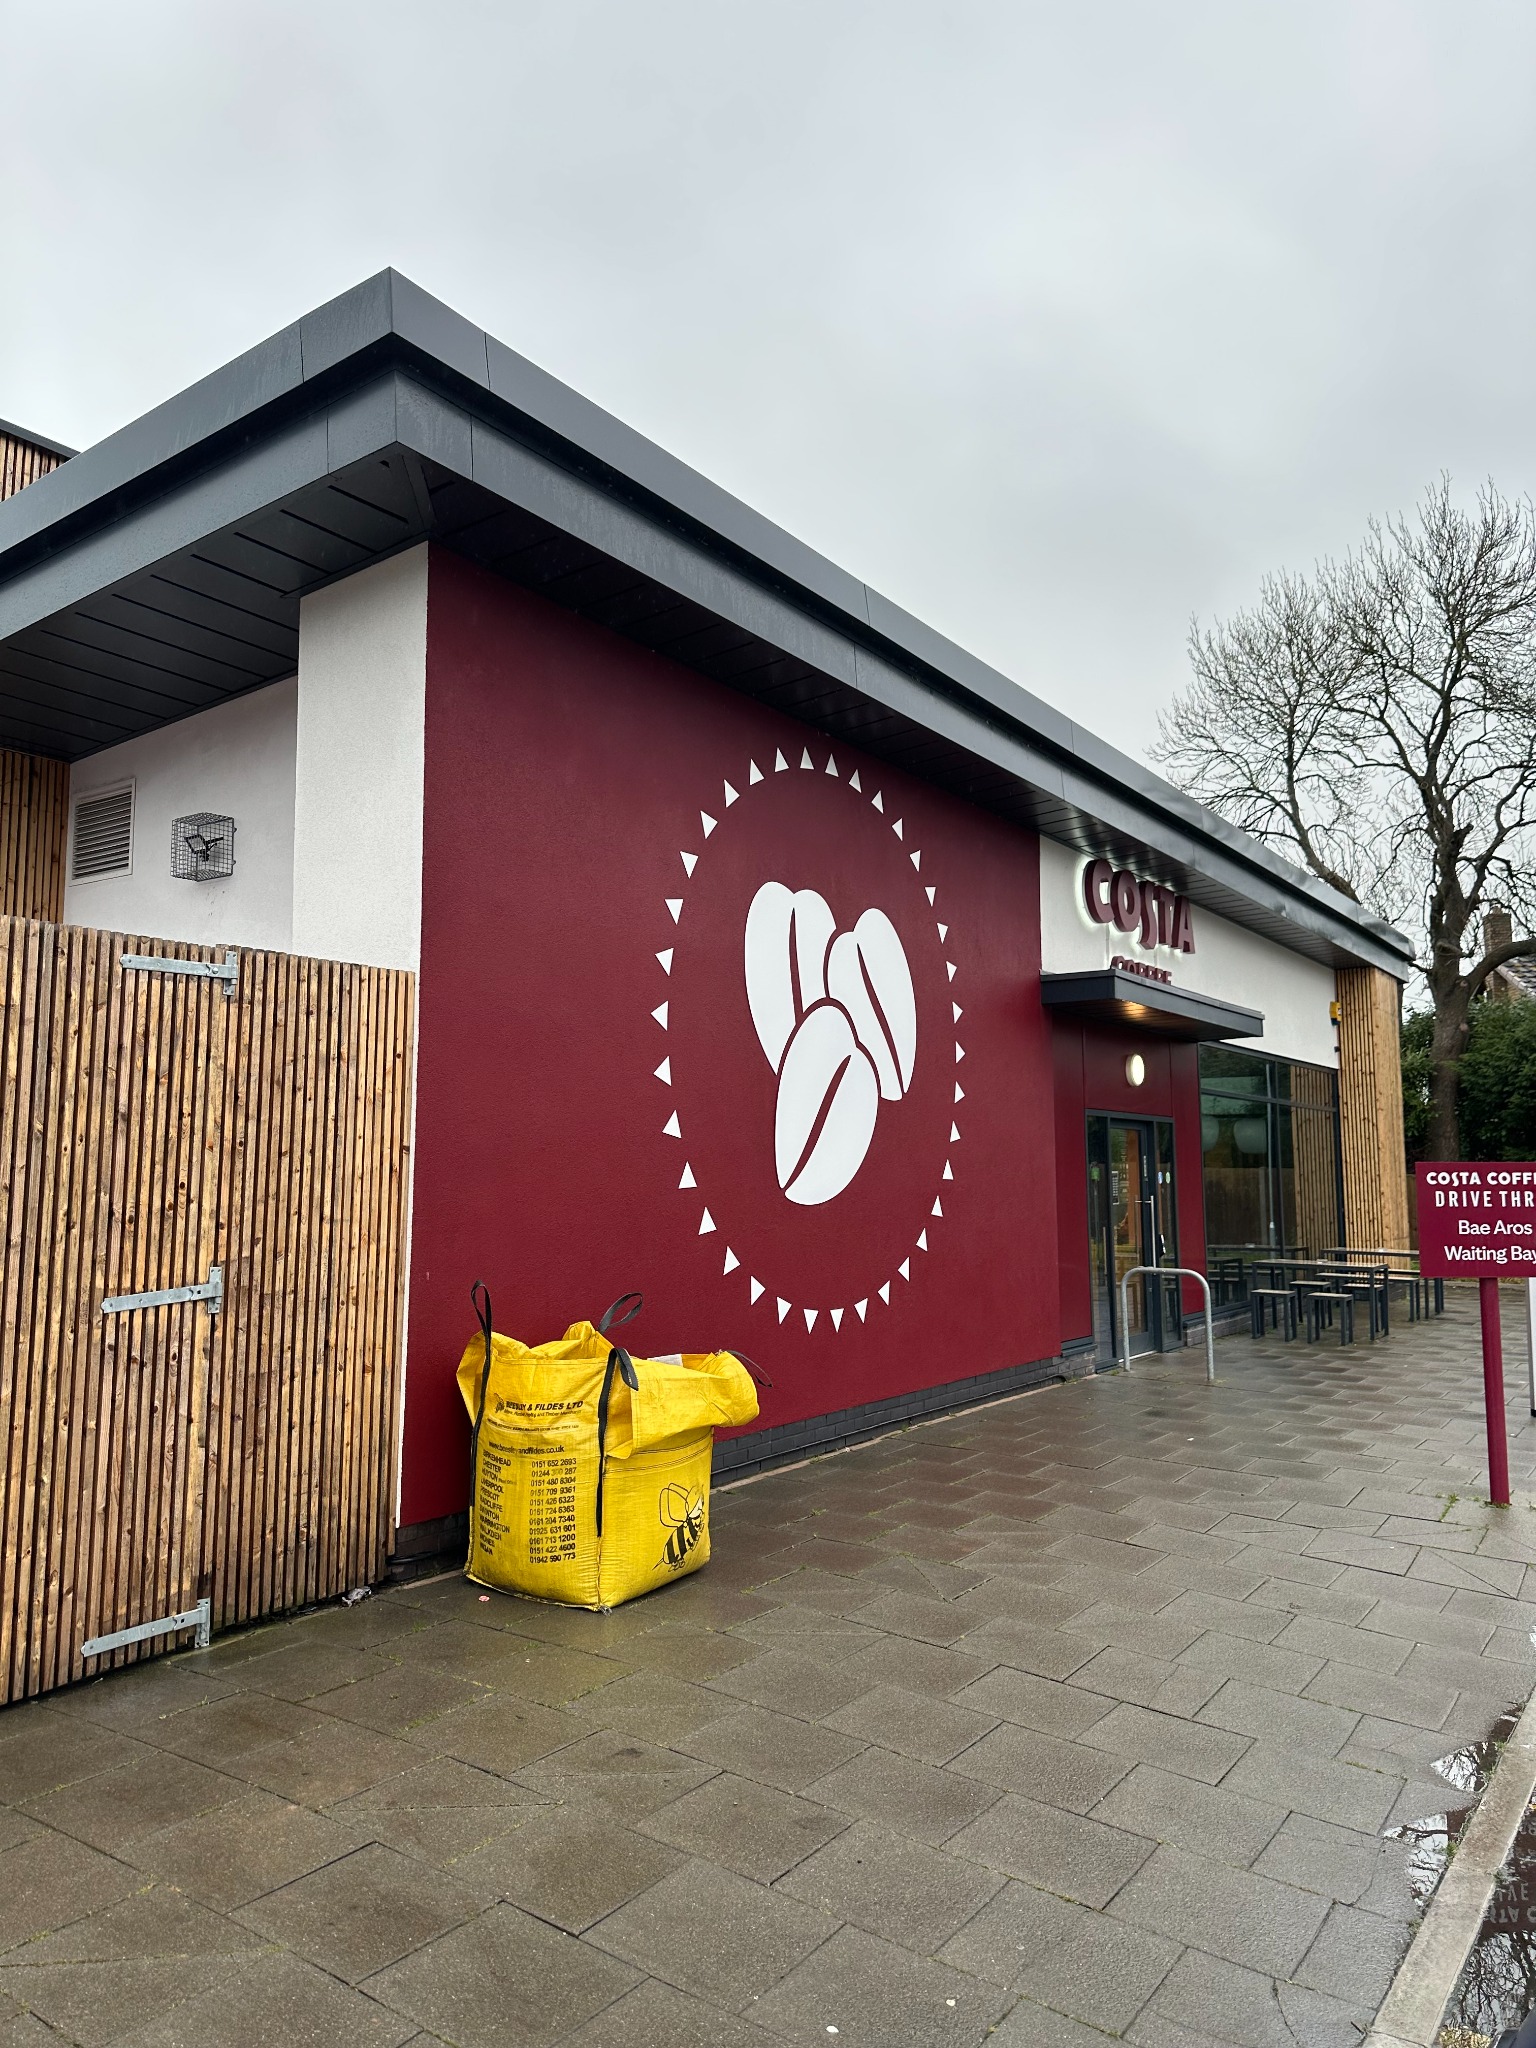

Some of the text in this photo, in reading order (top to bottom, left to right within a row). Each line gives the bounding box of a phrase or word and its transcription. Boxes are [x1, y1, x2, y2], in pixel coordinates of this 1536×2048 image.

[1084, 858, 1196, 954] COSTA
[1426, 1172, 1536, 1187] COSTA COFF
[1435, 1190, 1493, 1208] DRIVE
[1458, 1219, 1533, 1235] Bae Aros
[1444, 1245, 1507, 1265] Waiting
[527, 1403, 533, 1412] &
[534, 1403, 564, 1411] FILDES
[566, 1400, 584, 1410] LTD
[565, 1467, 577, 1475] 287
[531, 1479, 544, 1487] 0151
[546, 1488, 557, 1496] 709
[558, 1495, 575, 1504] 6323
[558, 1515, 575, 1523] 7340
[563, 1524, 576, 1532] 601
[558, 1534, 576, 1542] 1200
[530, 1556, 548, 1564] 01942
[563, 1552, 576, 1560] 773
